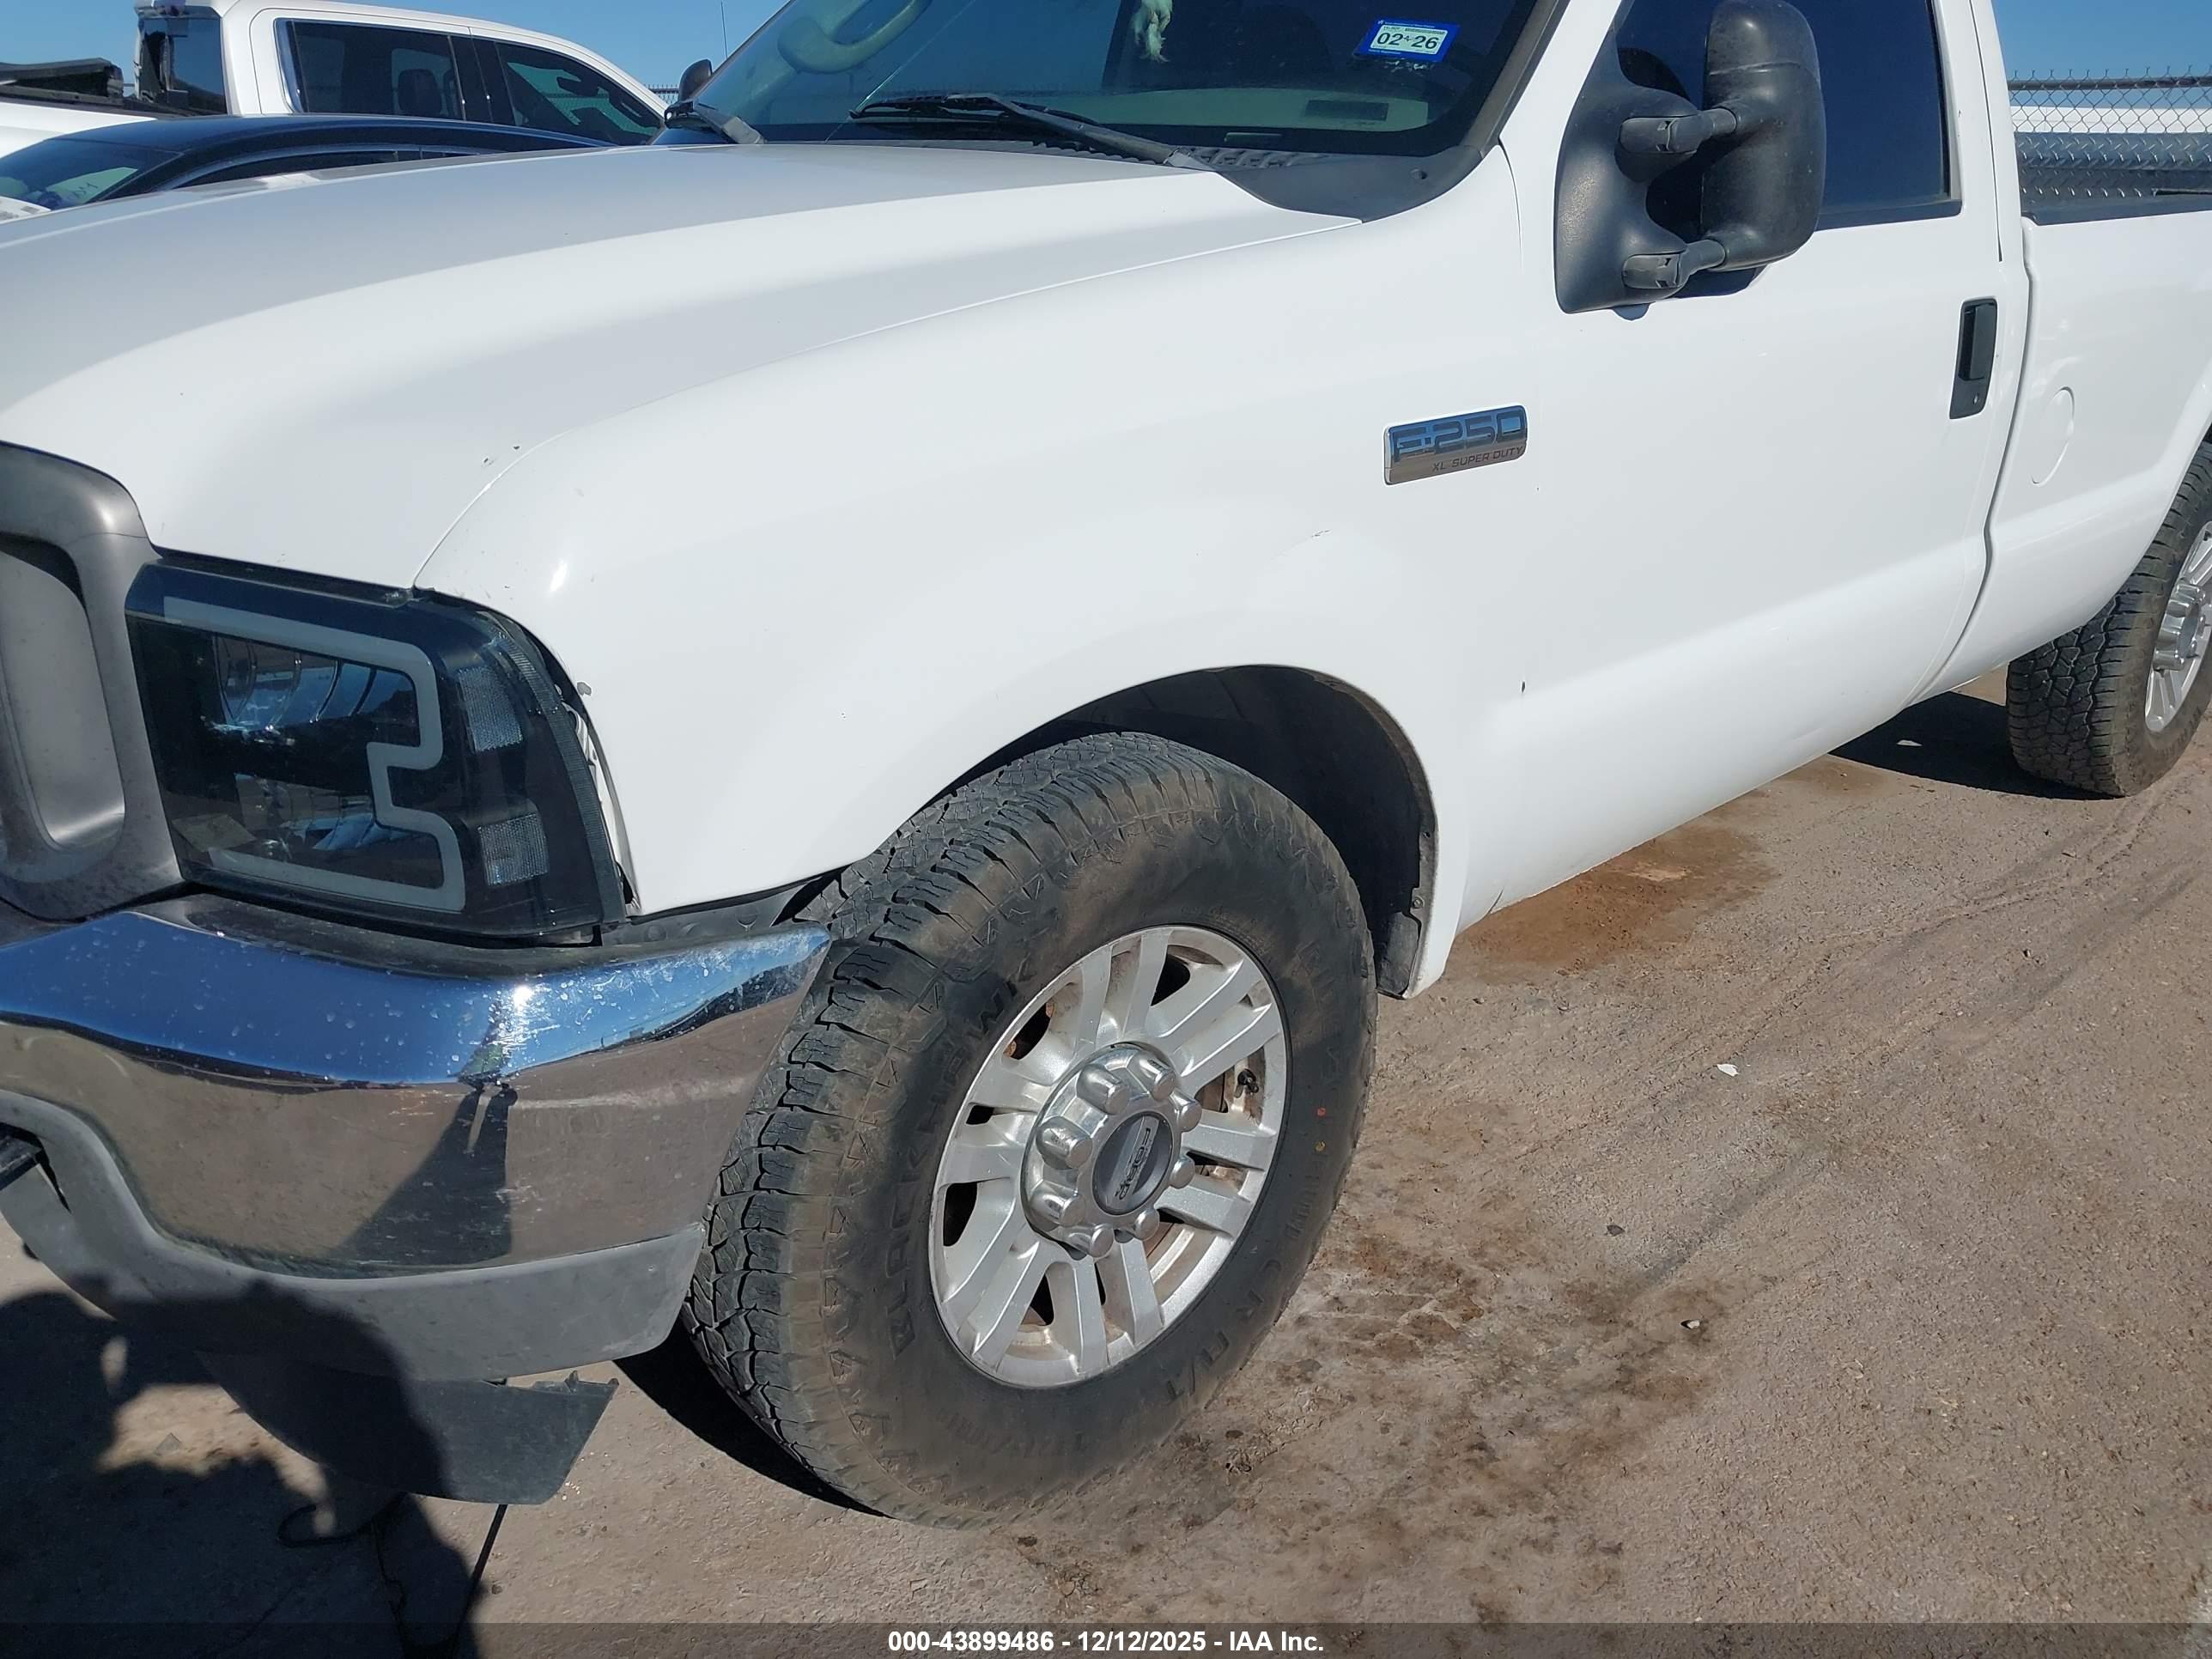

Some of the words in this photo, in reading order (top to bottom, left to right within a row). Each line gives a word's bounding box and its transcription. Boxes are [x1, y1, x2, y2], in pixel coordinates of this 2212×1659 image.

[1376, 32, 1404, 46] 02
[1411, 35, 1439, 49] 26
[1392, 410, 1527, 463] F-250
[1431, 462, 1447, 472] XL
[1450, 452, 1490, 469] SUPER
[1492, 446, 1524, 460] DUTY
